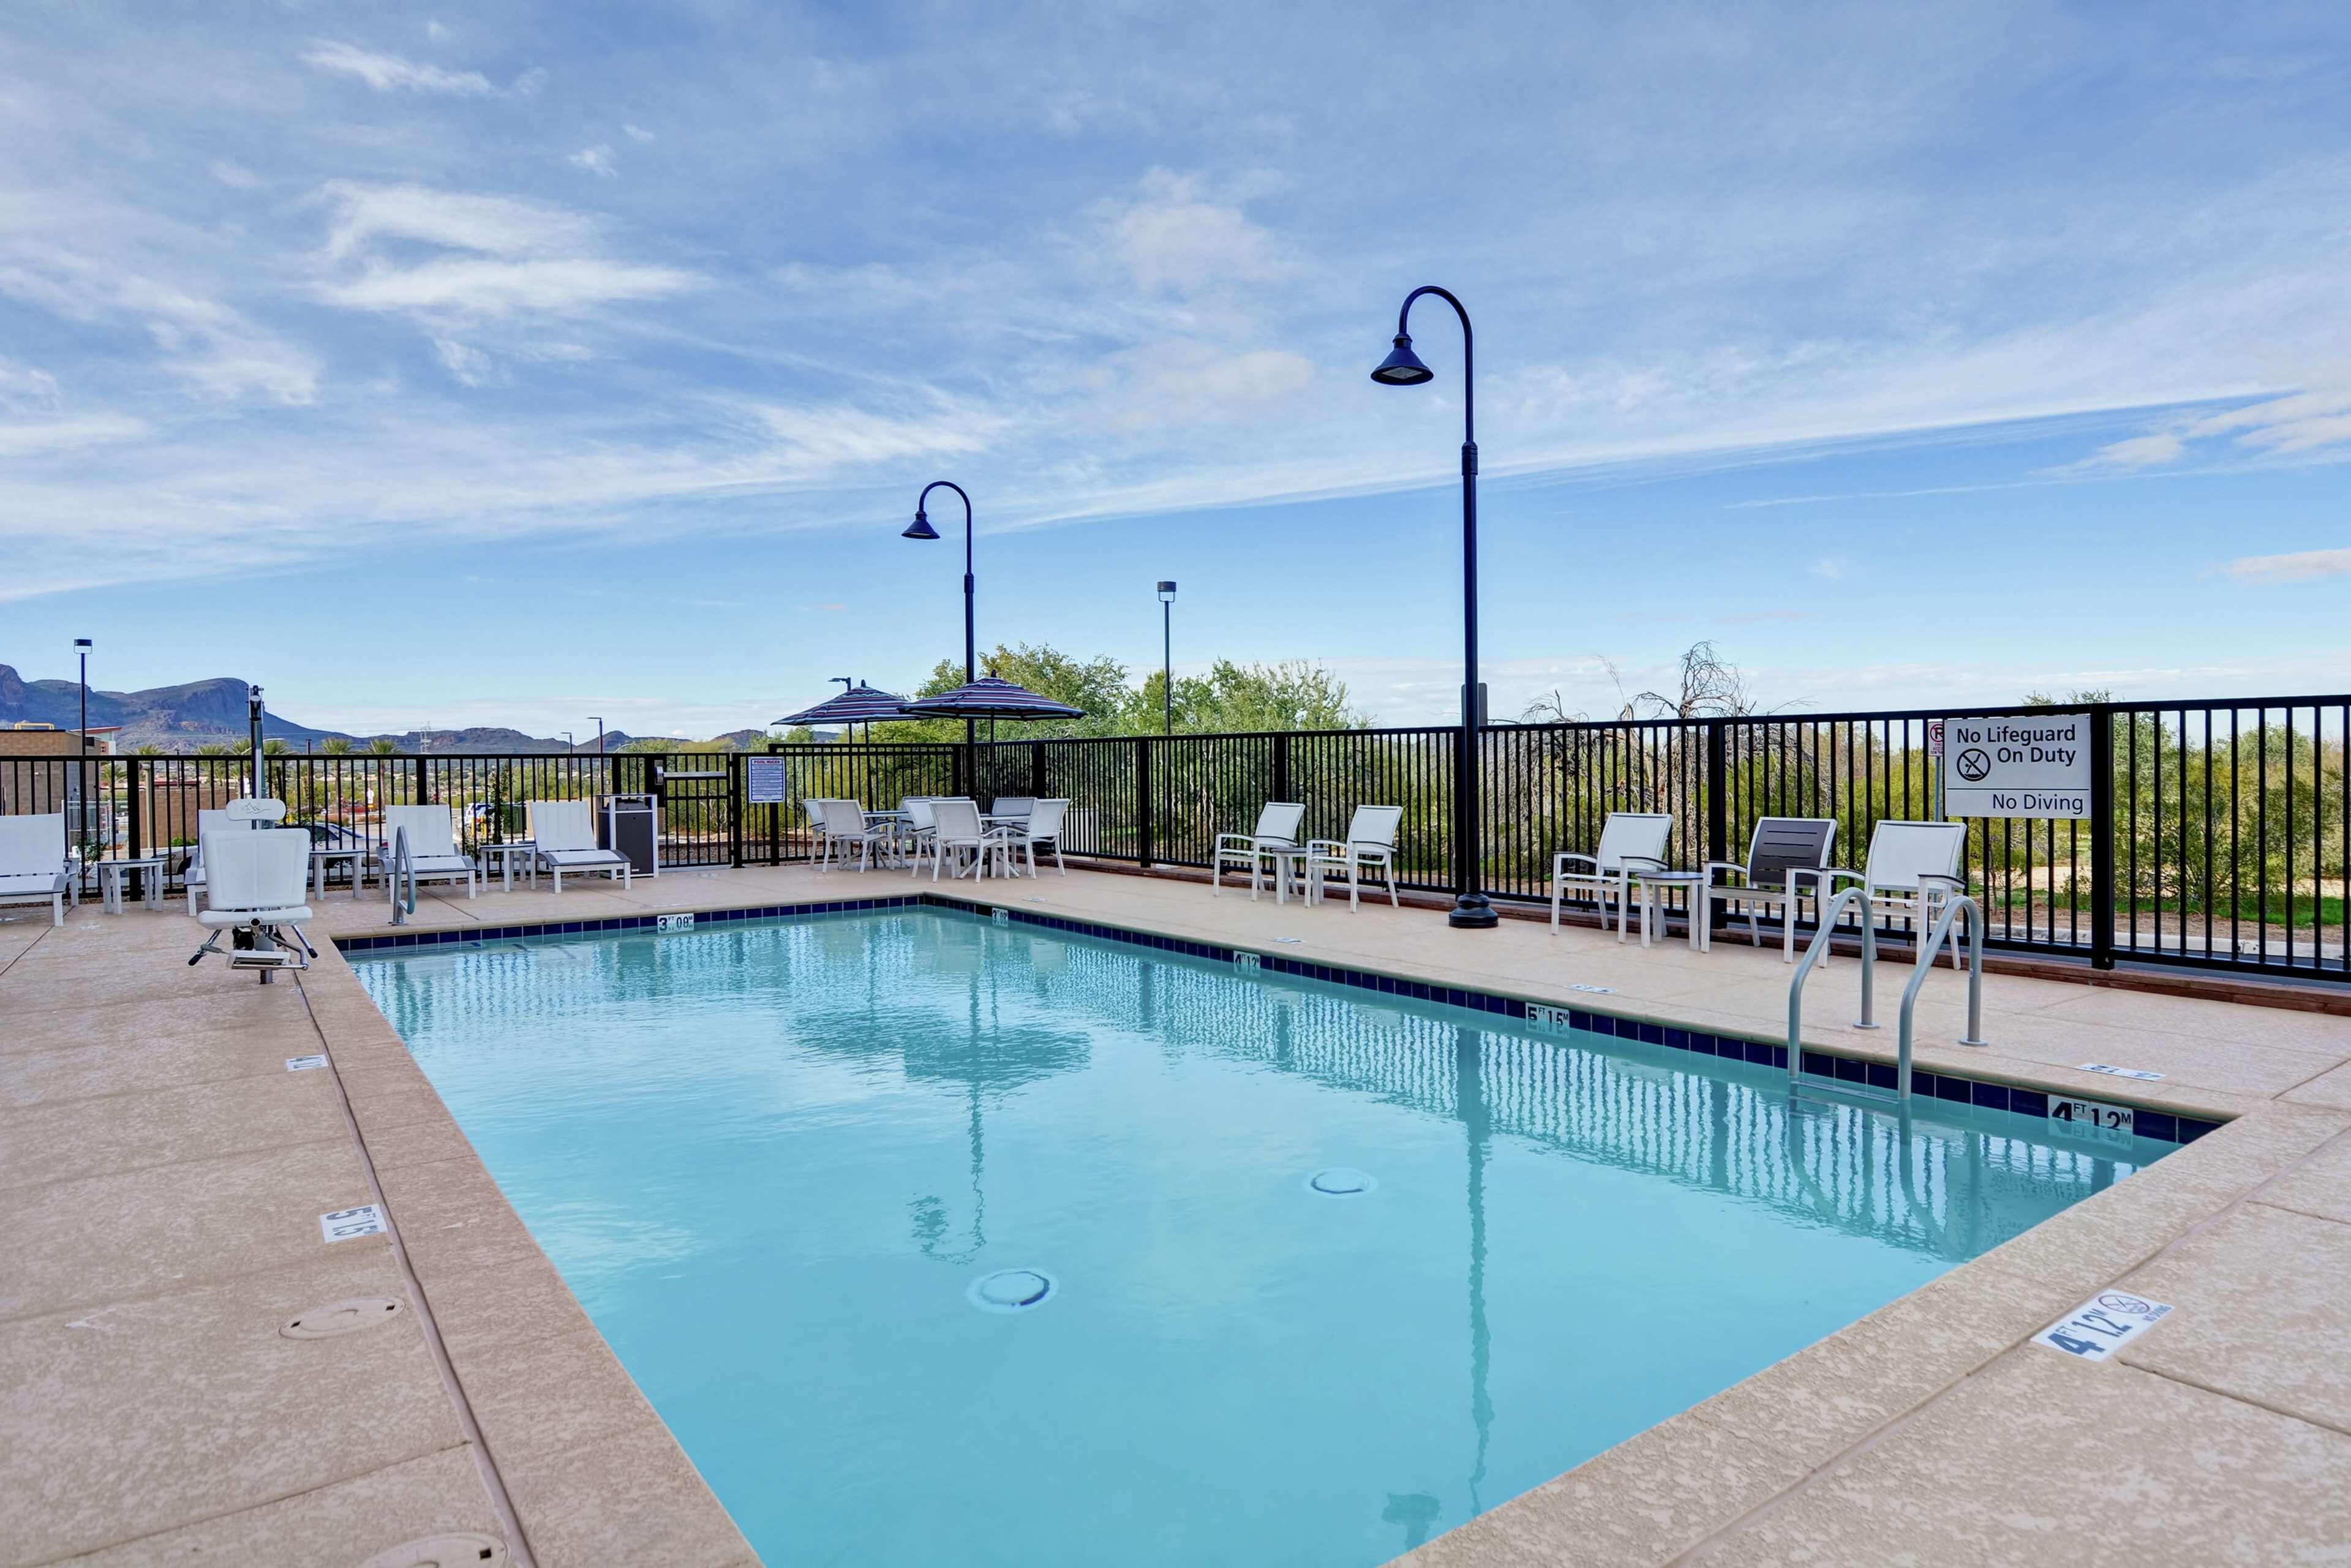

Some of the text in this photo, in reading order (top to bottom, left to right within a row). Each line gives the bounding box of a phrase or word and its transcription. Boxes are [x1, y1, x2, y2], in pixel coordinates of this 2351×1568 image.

[1957, 724, 2076, 746] No Lifeguard
[1998, 747, 2077, 767] On Duty
[1993, 793, 2083, 815] No Diving
